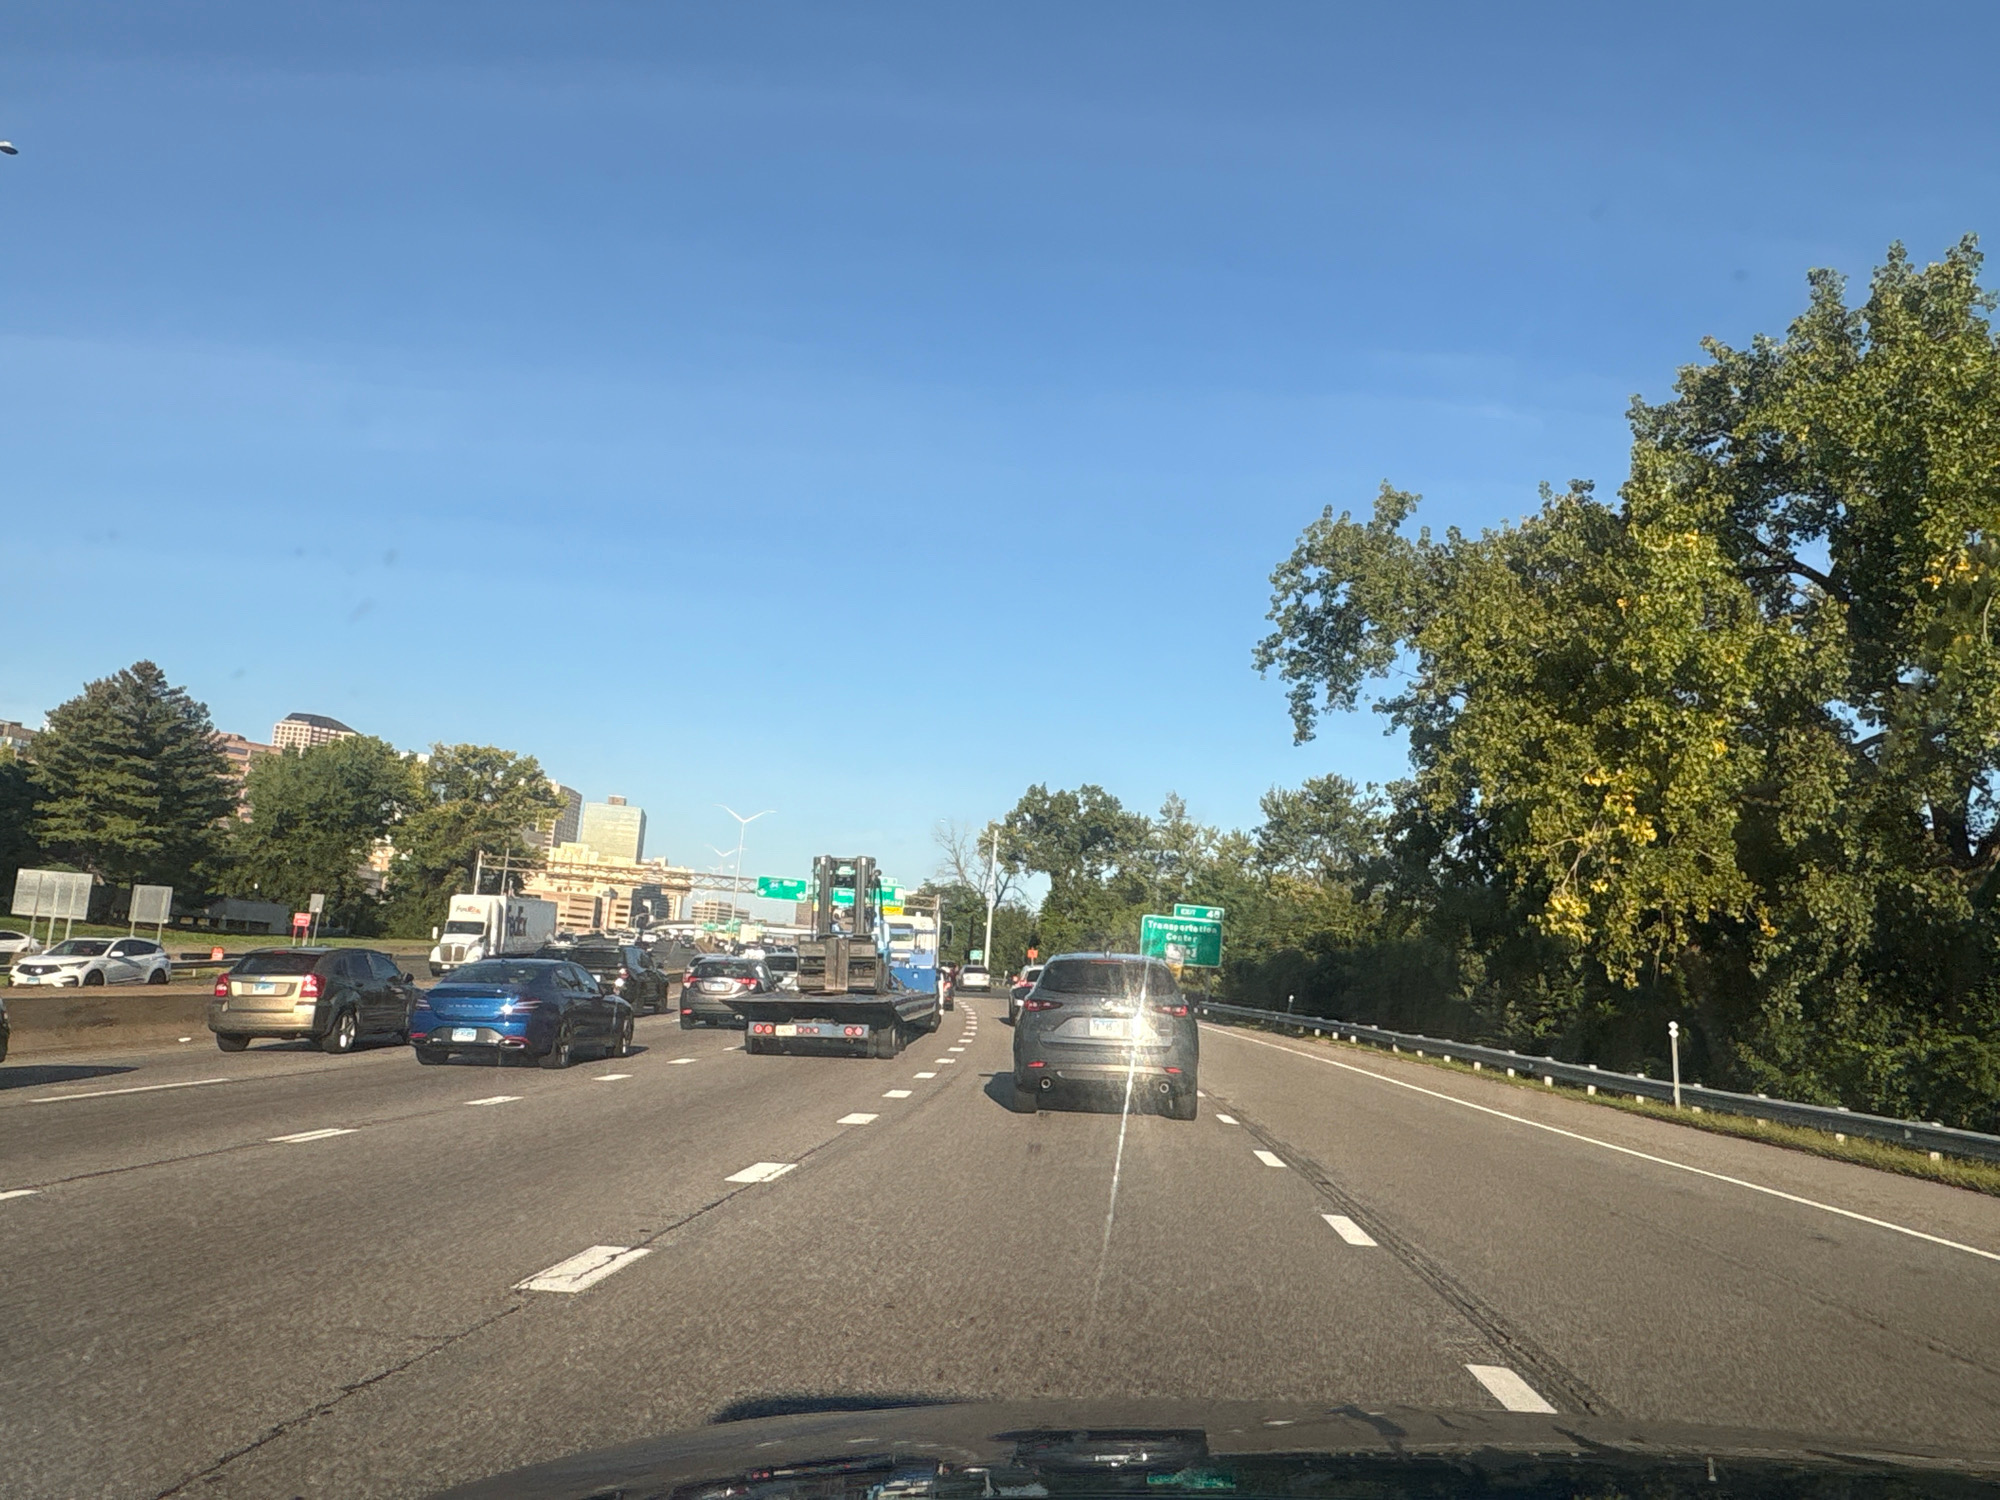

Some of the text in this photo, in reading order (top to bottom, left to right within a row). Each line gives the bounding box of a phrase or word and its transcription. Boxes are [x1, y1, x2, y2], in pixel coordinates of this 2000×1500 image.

[1180, 908, 1196, 916] EXIT
[1148, 920, 1217, 934] Transportation
[1165, 932, 1198, 943] Center
